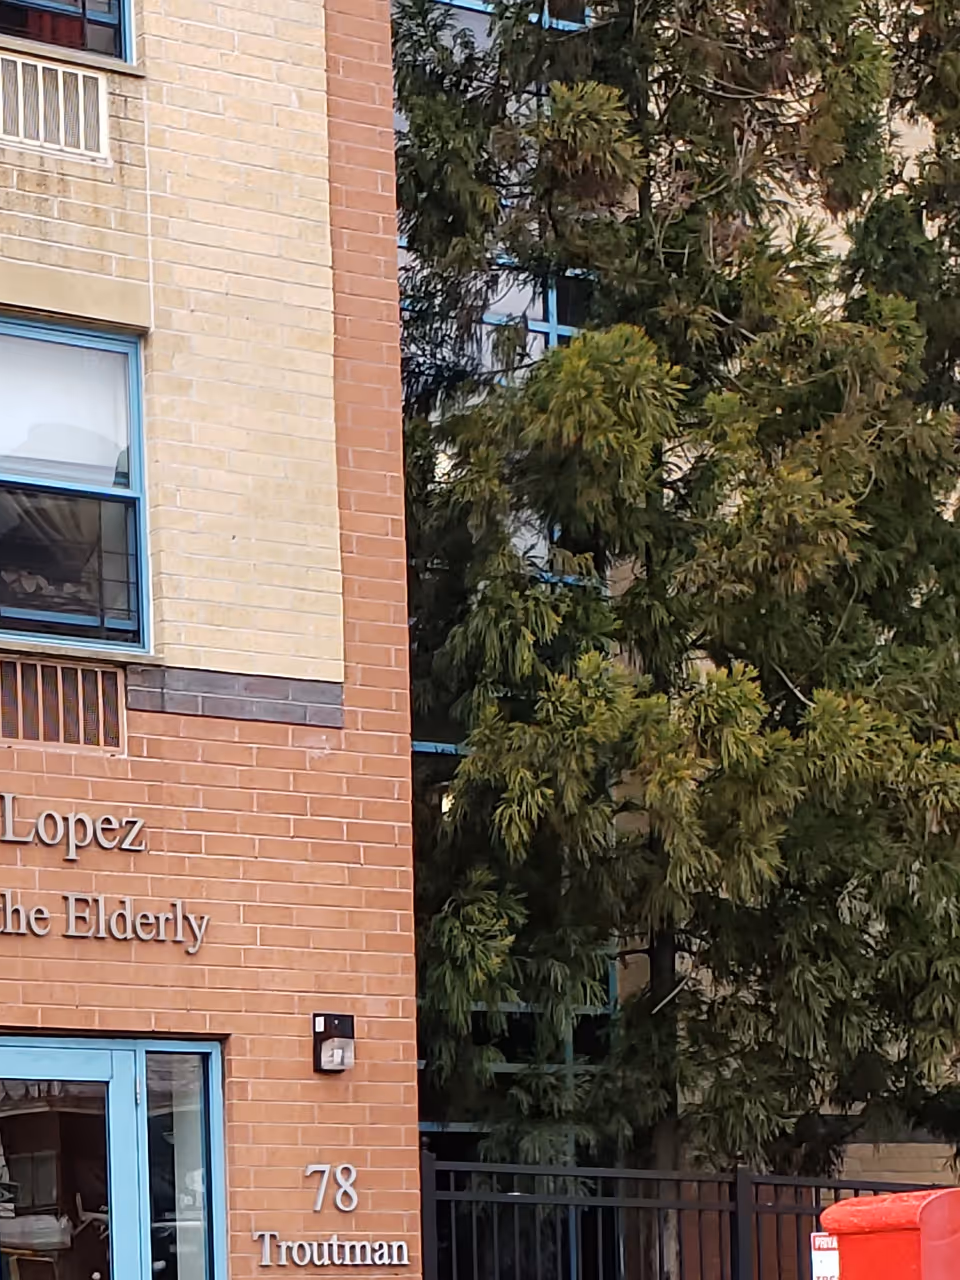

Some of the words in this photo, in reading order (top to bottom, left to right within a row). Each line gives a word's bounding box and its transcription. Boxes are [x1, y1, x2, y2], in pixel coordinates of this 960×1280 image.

[61, 891, 212, 955] Elderly
[304, 1163, 360, 1213] 78
[252, 1230, 411, 1267] Troutman
